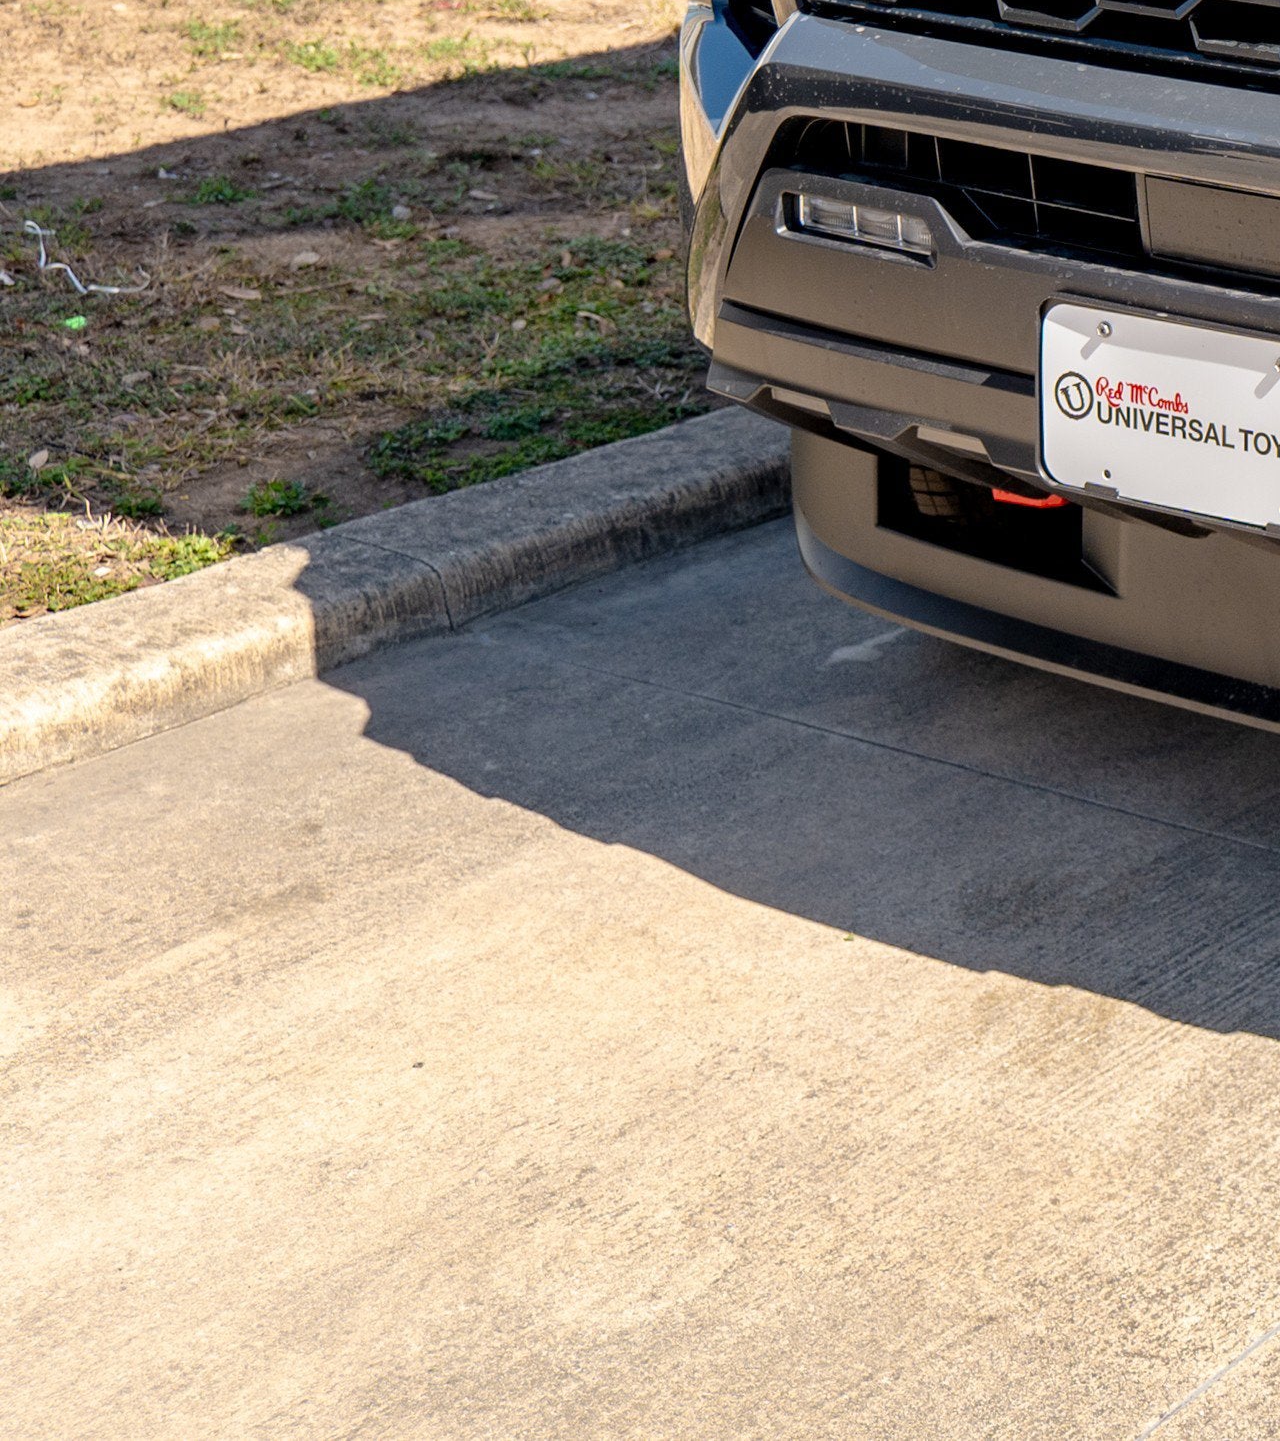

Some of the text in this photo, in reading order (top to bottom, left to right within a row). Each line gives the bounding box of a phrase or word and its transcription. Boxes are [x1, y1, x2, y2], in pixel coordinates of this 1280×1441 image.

[1096, 376, 1189, 414] Red McCombs
[1097, 401, 1236, 450] UNIVERSAL
